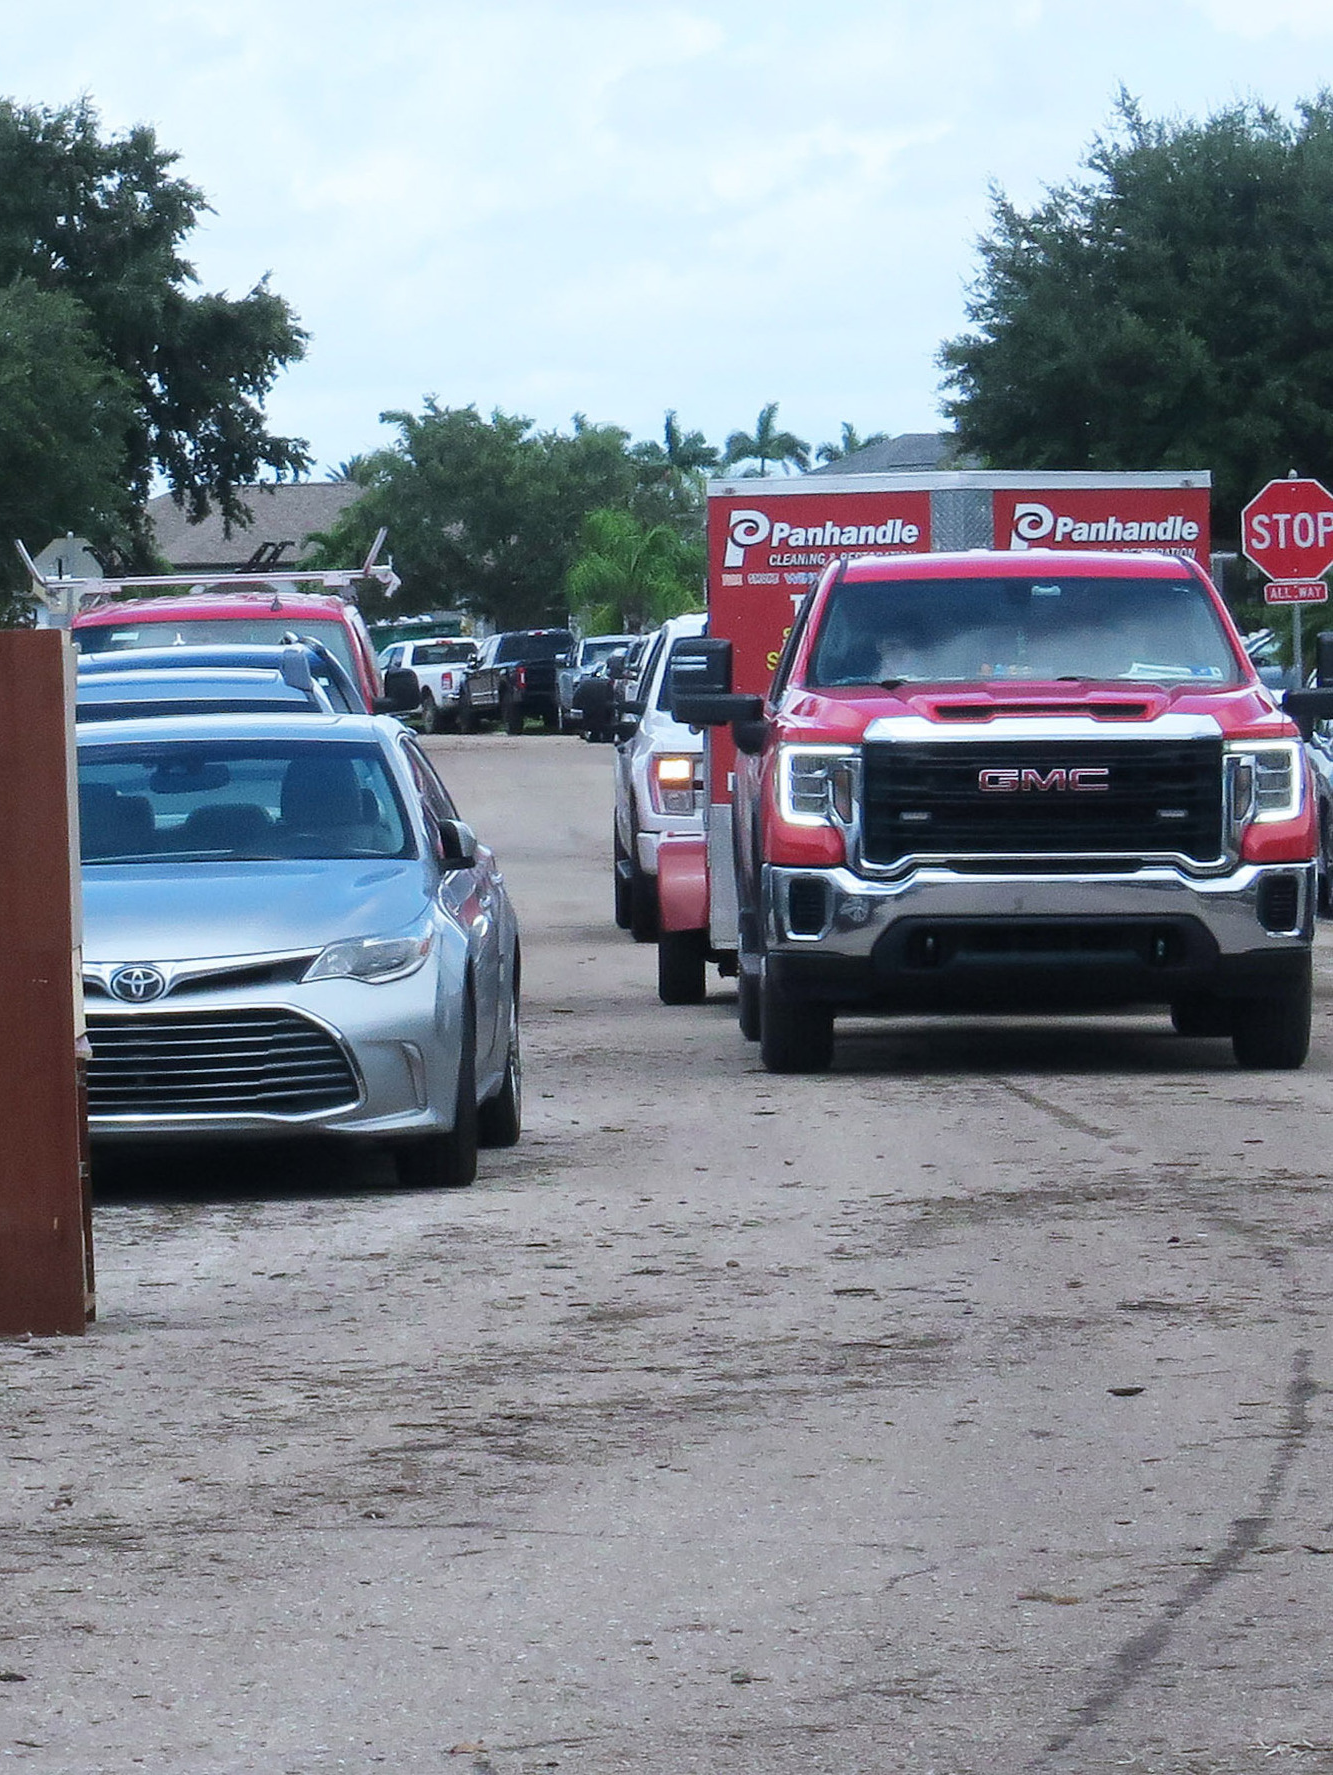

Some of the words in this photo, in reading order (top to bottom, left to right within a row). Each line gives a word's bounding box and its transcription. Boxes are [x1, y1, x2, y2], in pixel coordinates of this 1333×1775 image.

[771, 518, 920, 548] Panhandle
[1054, 515, 1200, 543] Panhandle
[1251, 511, 1333, 550] STOP
[769, 552, 826, 567] CLEANING
[1270, 587, 1292, 600] ALL
[1298, 586, 1322, 599] WAY
[978, 767, 1110, 792] GMC
